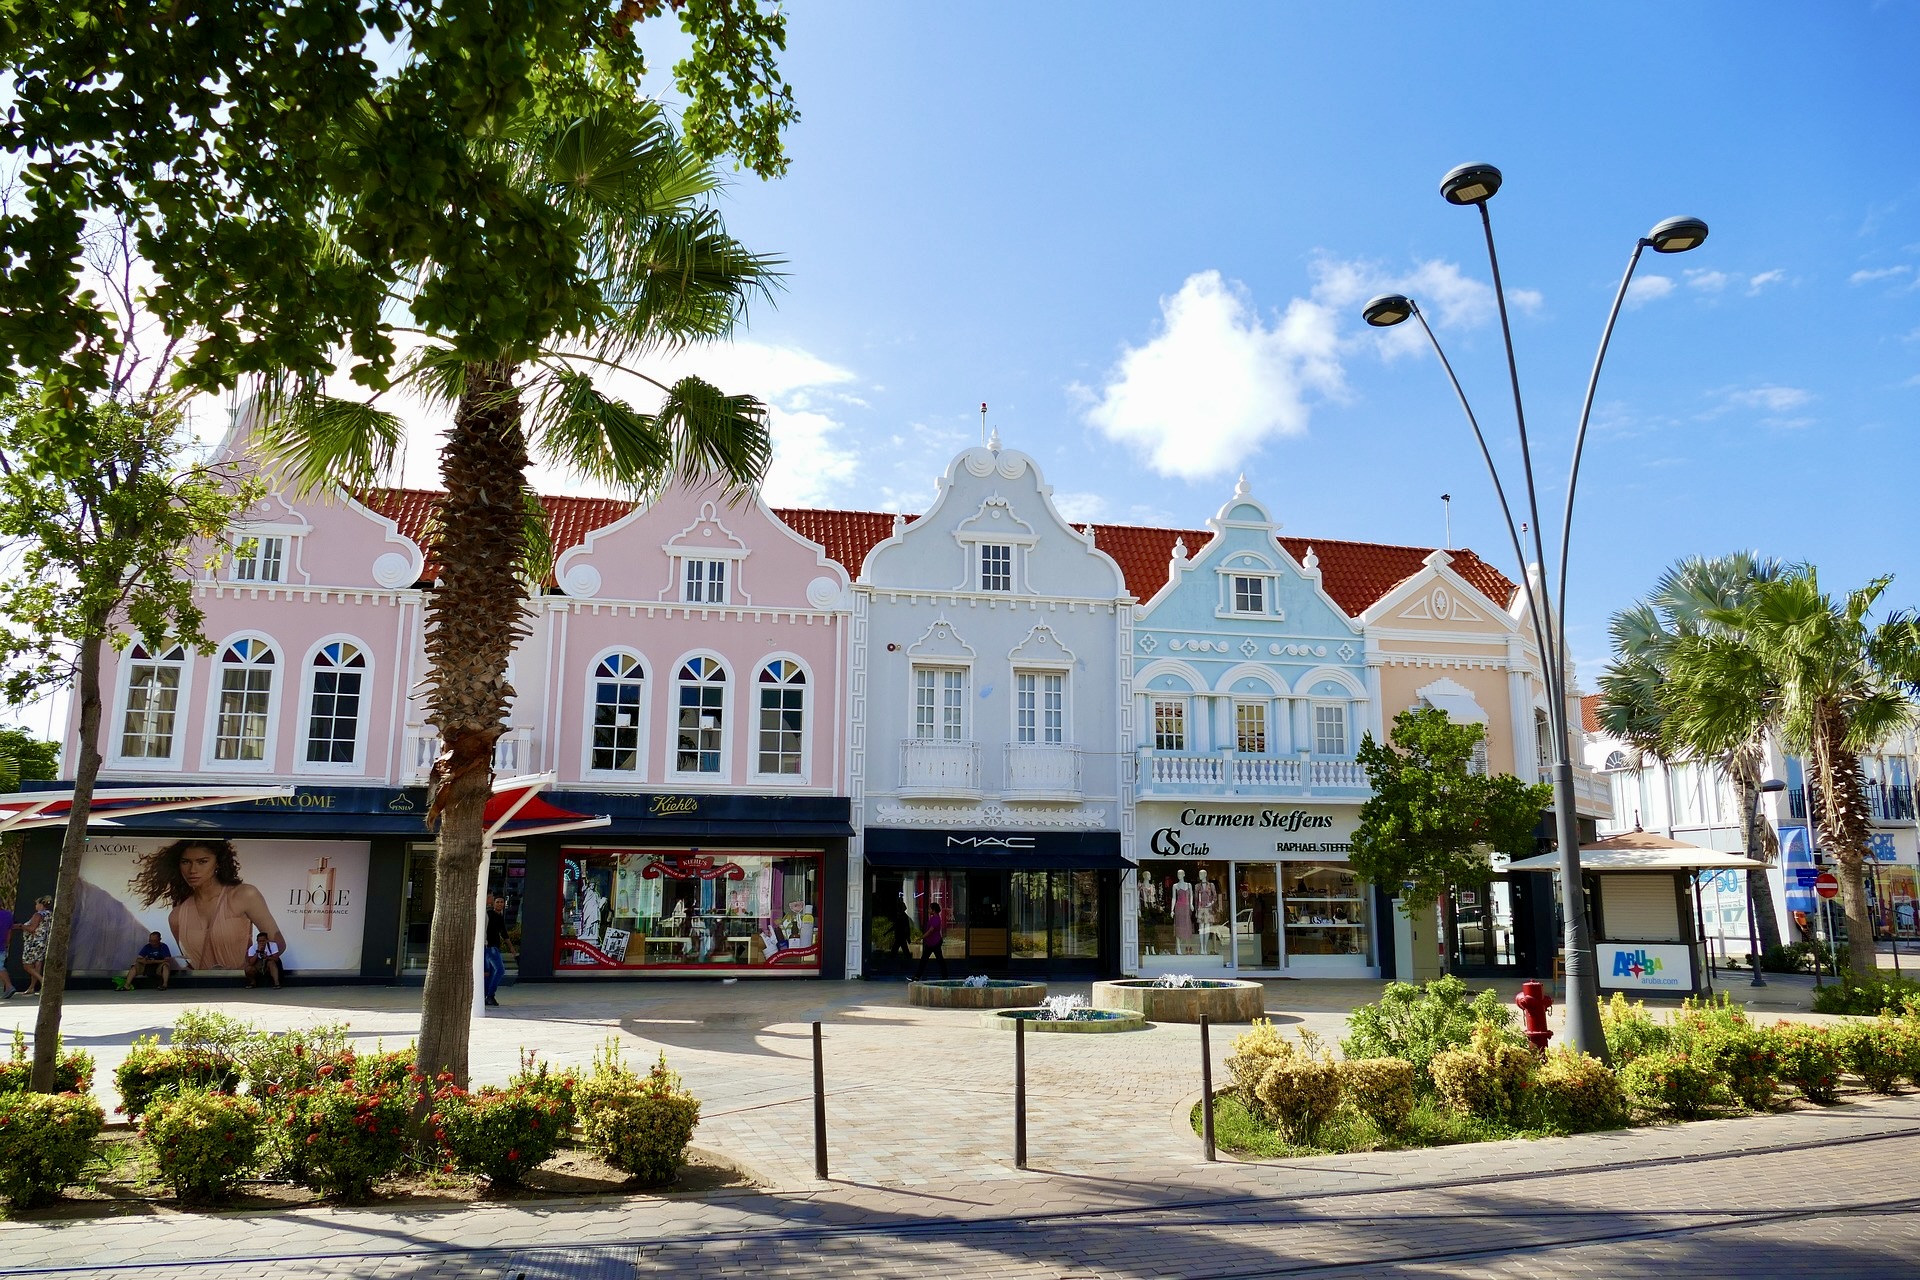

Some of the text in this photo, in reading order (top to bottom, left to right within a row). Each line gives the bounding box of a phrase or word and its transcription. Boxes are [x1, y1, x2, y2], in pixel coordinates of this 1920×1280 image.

[255, 793, 336, 808] LANCÔME
[649, 796, 698, 812] Kiehl's
[1180, 808, 1333, 832] Carmen Steffens
[85, 843, 138, 853] LANCÔME
[1181, 843, 1210, 856] Club
[1276, 842, 1353, 852] RAPHAEL STEFFE
[288, 884, 350, 906] IDÔLE
[1613, 950, 1664, 976] ARUBA
[1641, 977, 1679, 985] aruba.com
